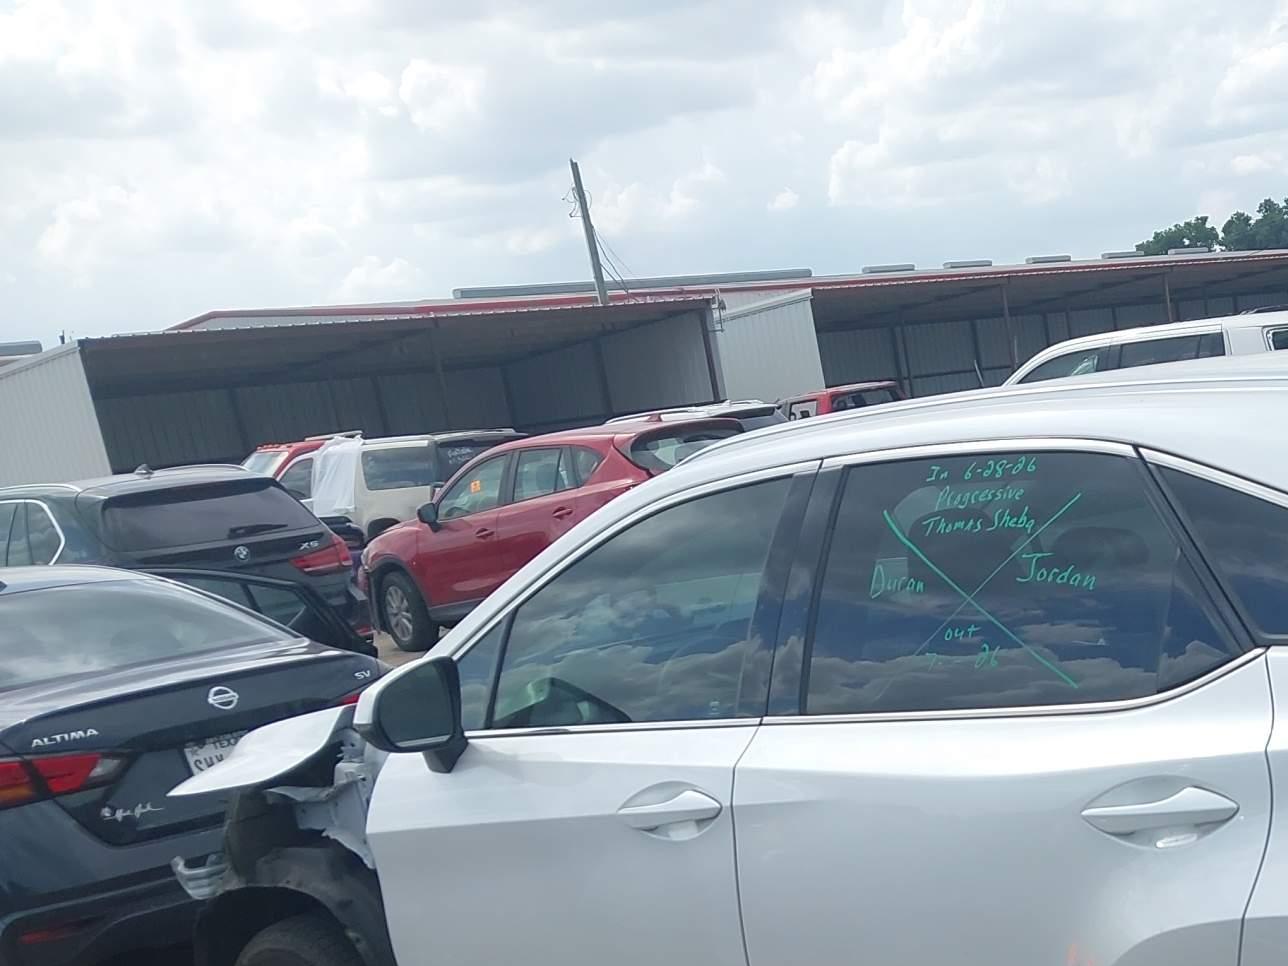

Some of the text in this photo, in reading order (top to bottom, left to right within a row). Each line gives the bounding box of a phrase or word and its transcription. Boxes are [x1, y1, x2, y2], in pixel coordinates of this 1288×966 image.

[926, 456, 1036, 482] In 6-28-26
[935, 486, 1025, 512] Progressive
[1016, 552, 1097, 591] Jordan
[354, 669, 370, 680] SV
[31, 728, 100, 748] ALTIMA
